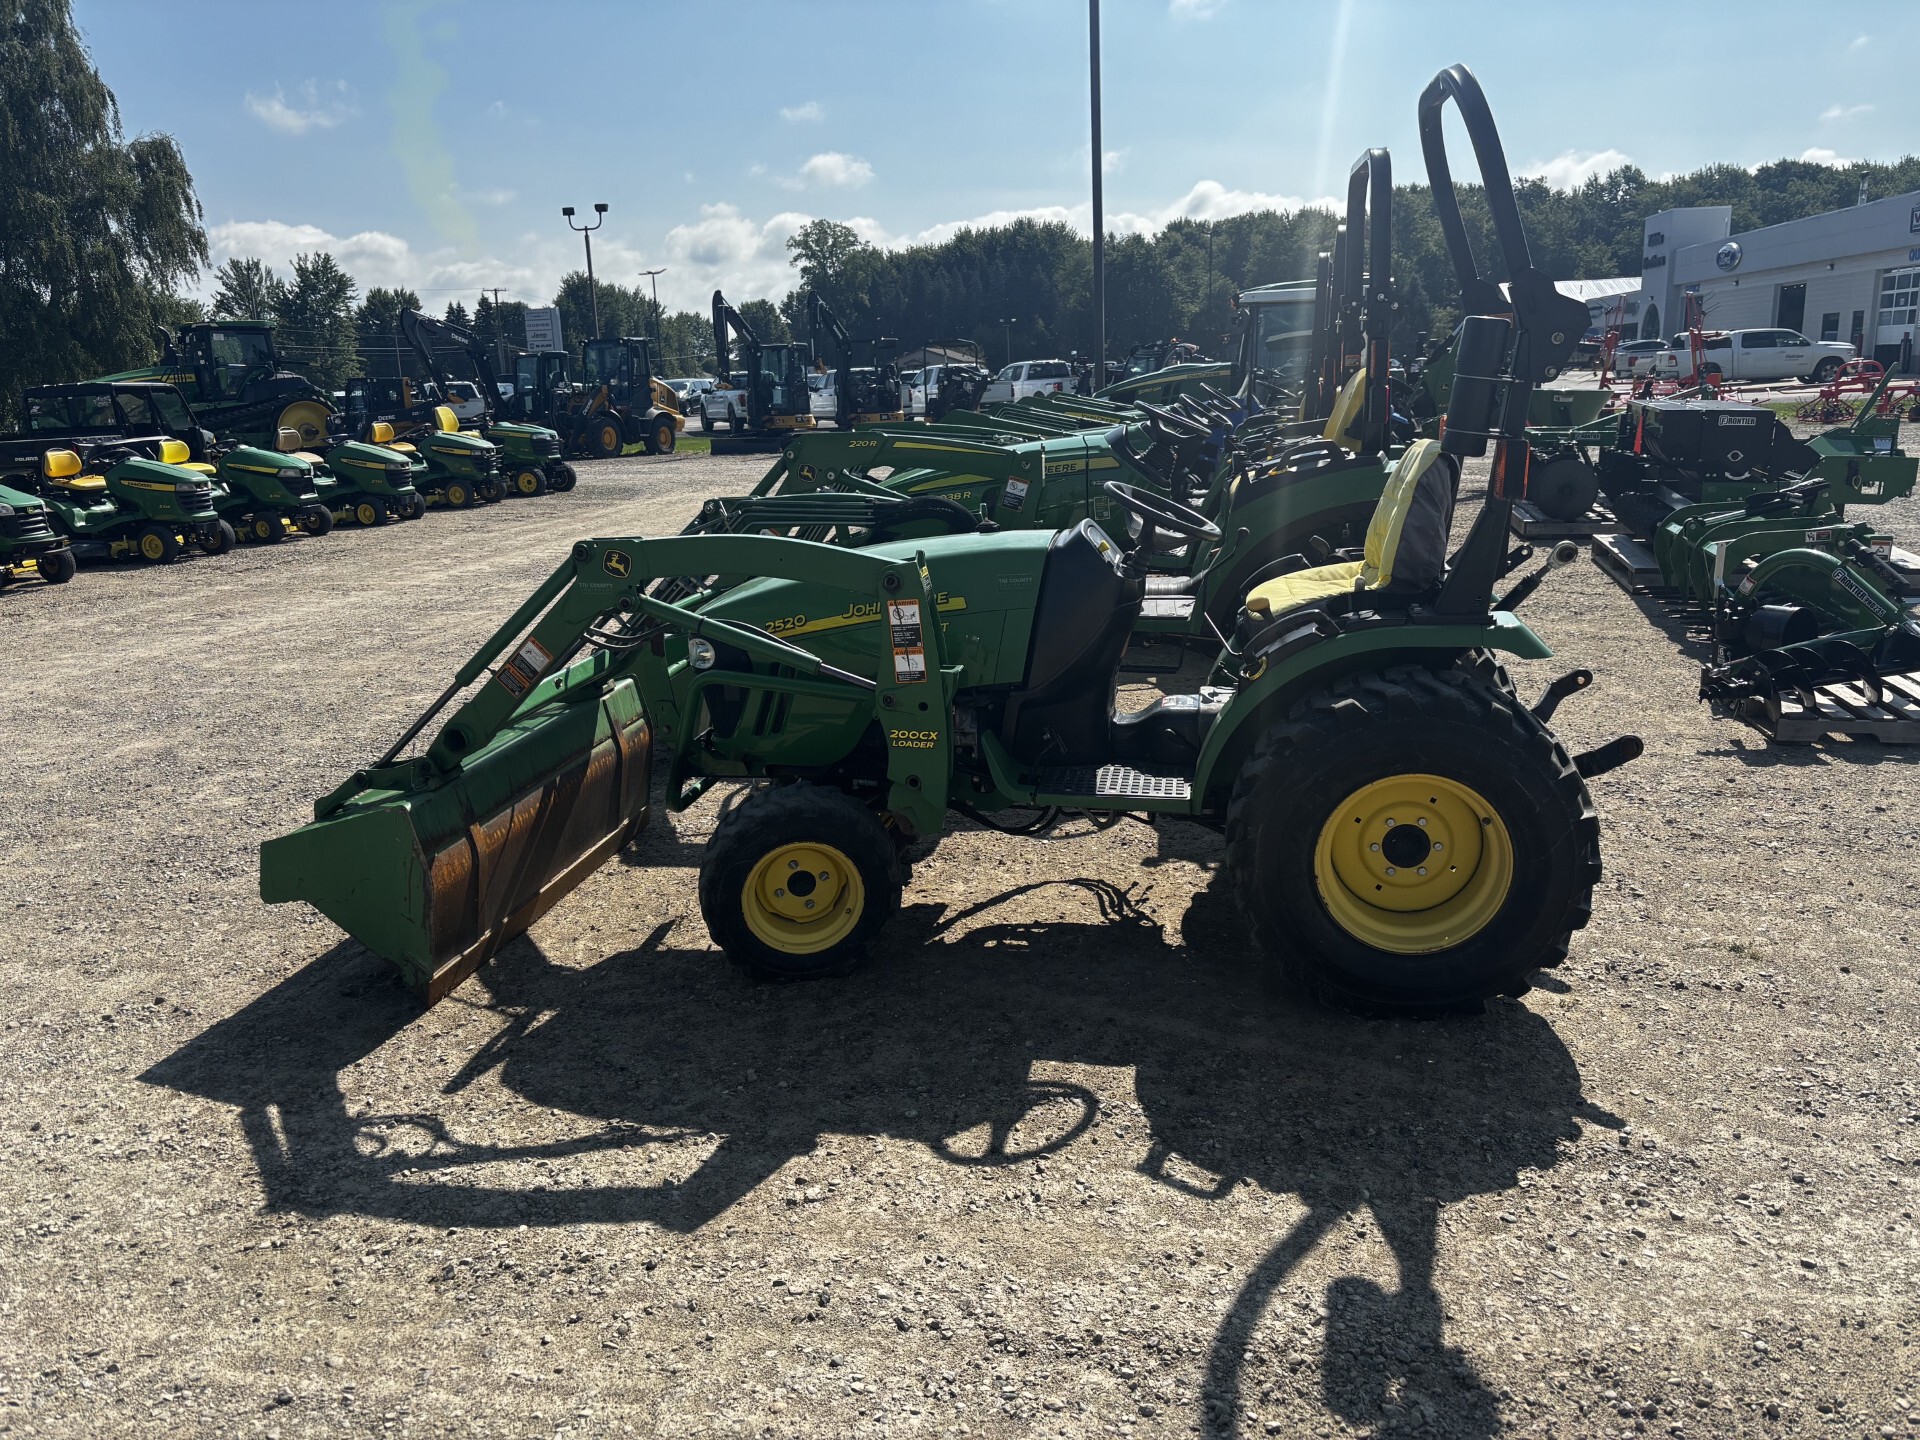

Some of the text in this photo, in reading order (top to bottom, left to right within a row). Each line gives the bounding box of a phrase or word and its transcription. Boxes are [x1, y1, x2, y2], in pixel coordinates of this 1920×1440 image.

[531, 332, 548, 340] Jeep
[1718, 415, 1756, 426] FRONTIER
[848, 440, 869, 448] 220
[963, 491, 971, 499] R
[1832, 568, 1868, 603] FRONTIER
[765, 614, 806, 634] 2520
[890, 730, 939, 740] 200CX
[892, 740, 934, 748] LOADER
